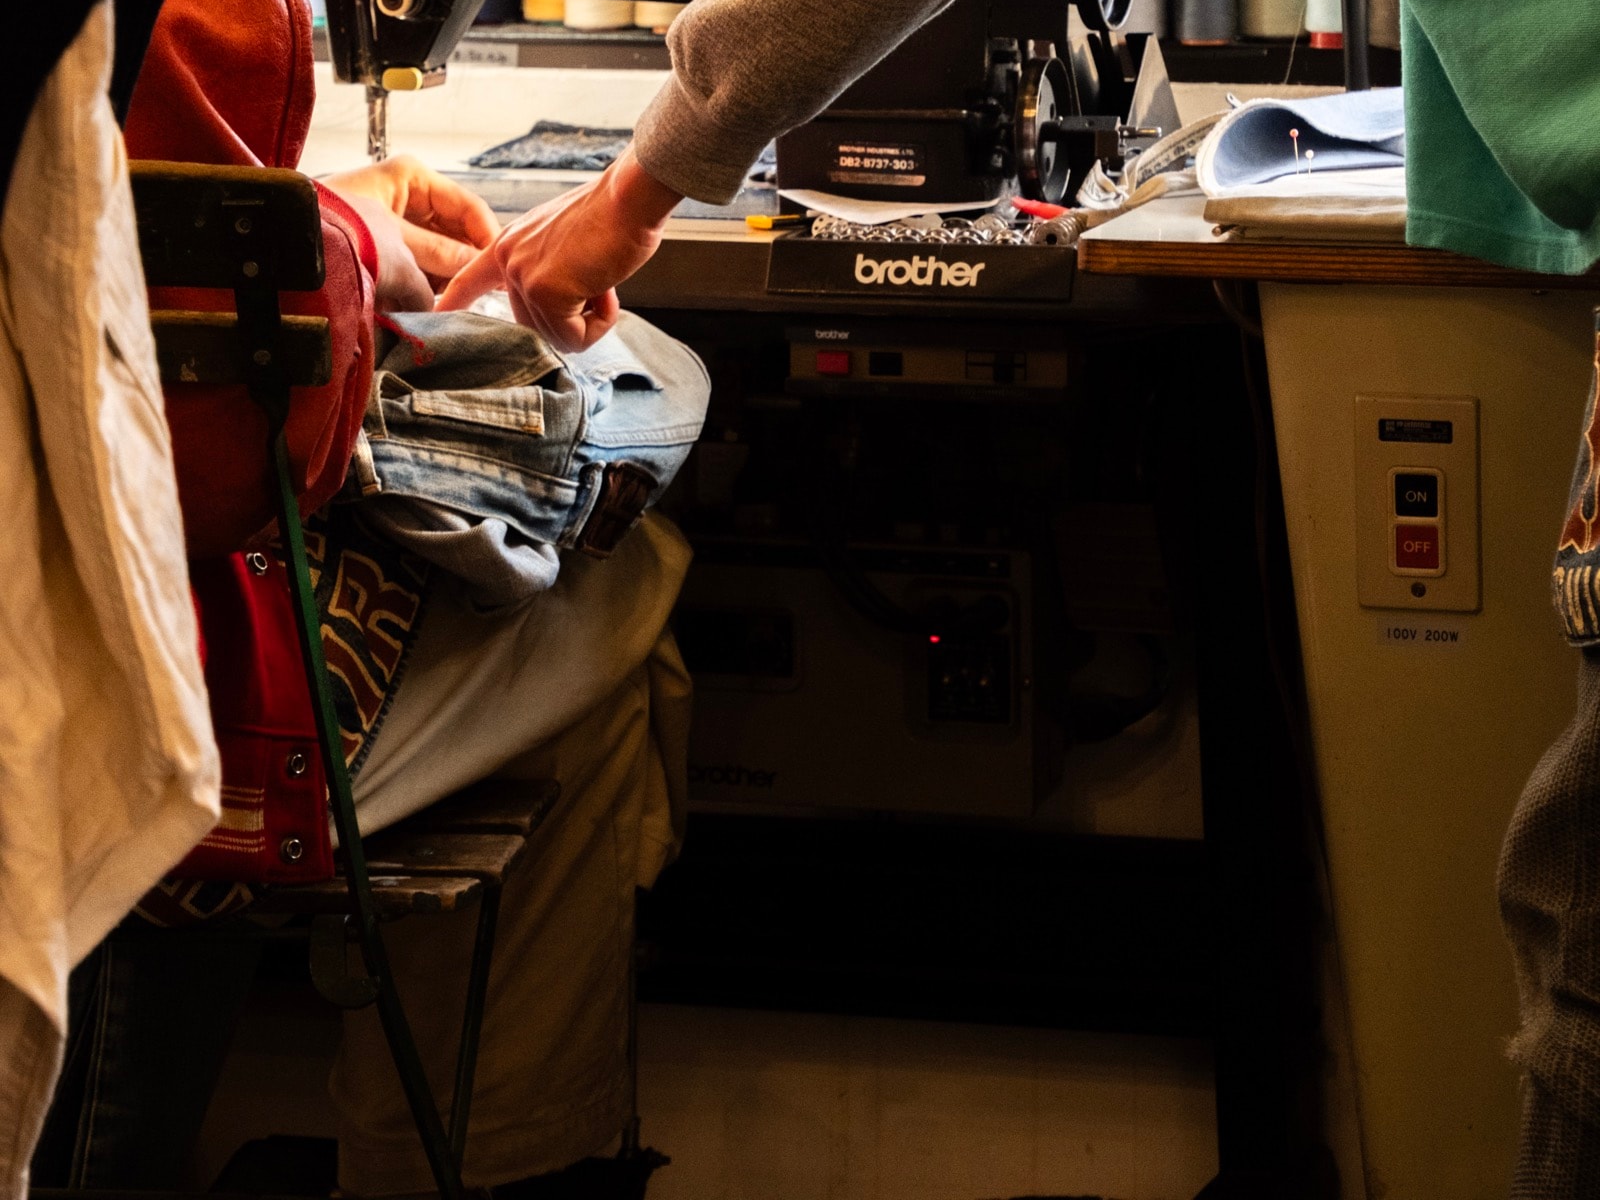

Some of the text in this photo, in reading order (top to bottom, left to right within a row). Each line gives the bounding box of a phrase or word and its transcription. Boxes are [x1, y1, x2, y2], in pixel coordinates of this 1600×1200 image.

[854, 253, 986, 288] brother
[815, 329, 850, 340] brother
[1405, 491, 1428, 503] ON
[1403, 540, 1432, 554] OFF
[1387, 627, 1460, 643] 100V 200W
